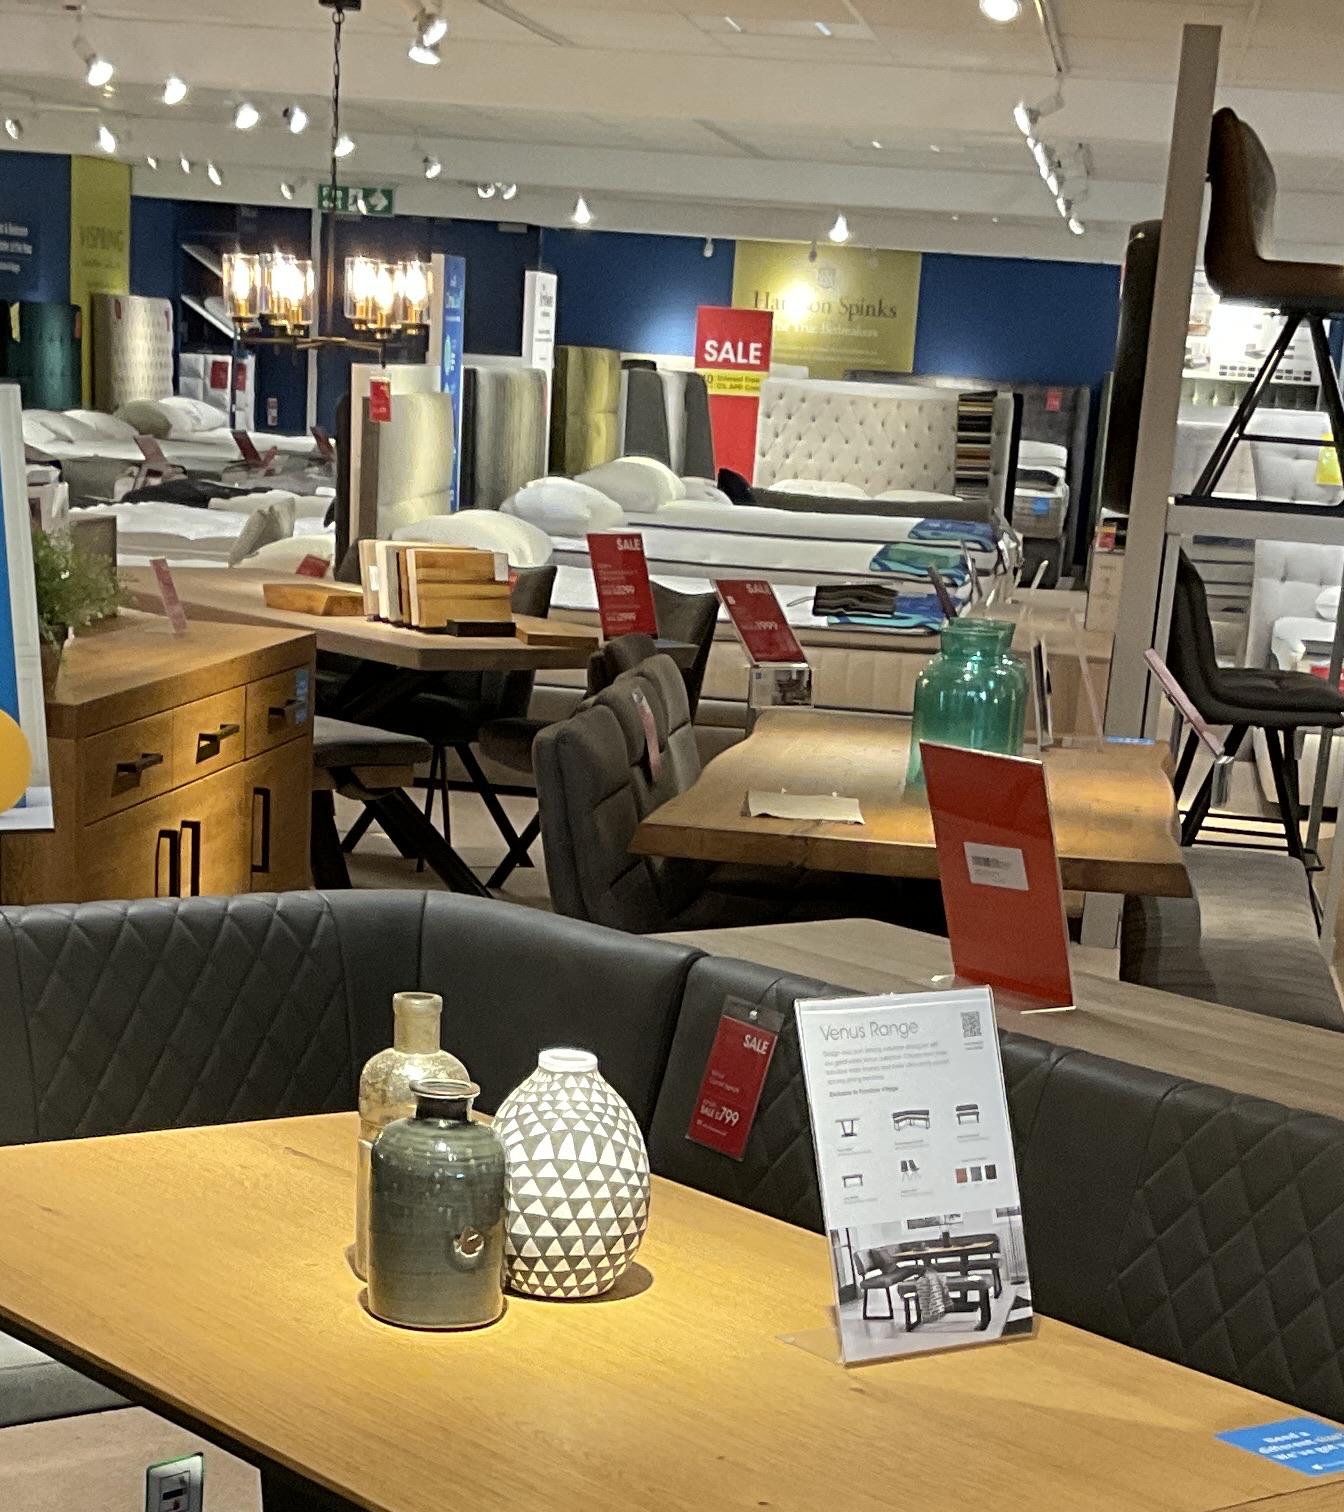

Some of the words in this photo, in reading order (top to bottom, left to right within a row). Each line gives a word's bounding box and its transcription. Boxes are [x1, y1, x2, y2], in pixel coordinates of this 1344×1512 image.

[754, 290, 832, 315] Haron
[838, 296, 897, 321] Spinks
[704, 340, 762, 365] SALE
[617, 538, 641, 551] SALE
[820, 1025, 865, 1041] Venus
[869, 1021, 918, 1039] Range
[743, 1034, 769, 1055] SALE
